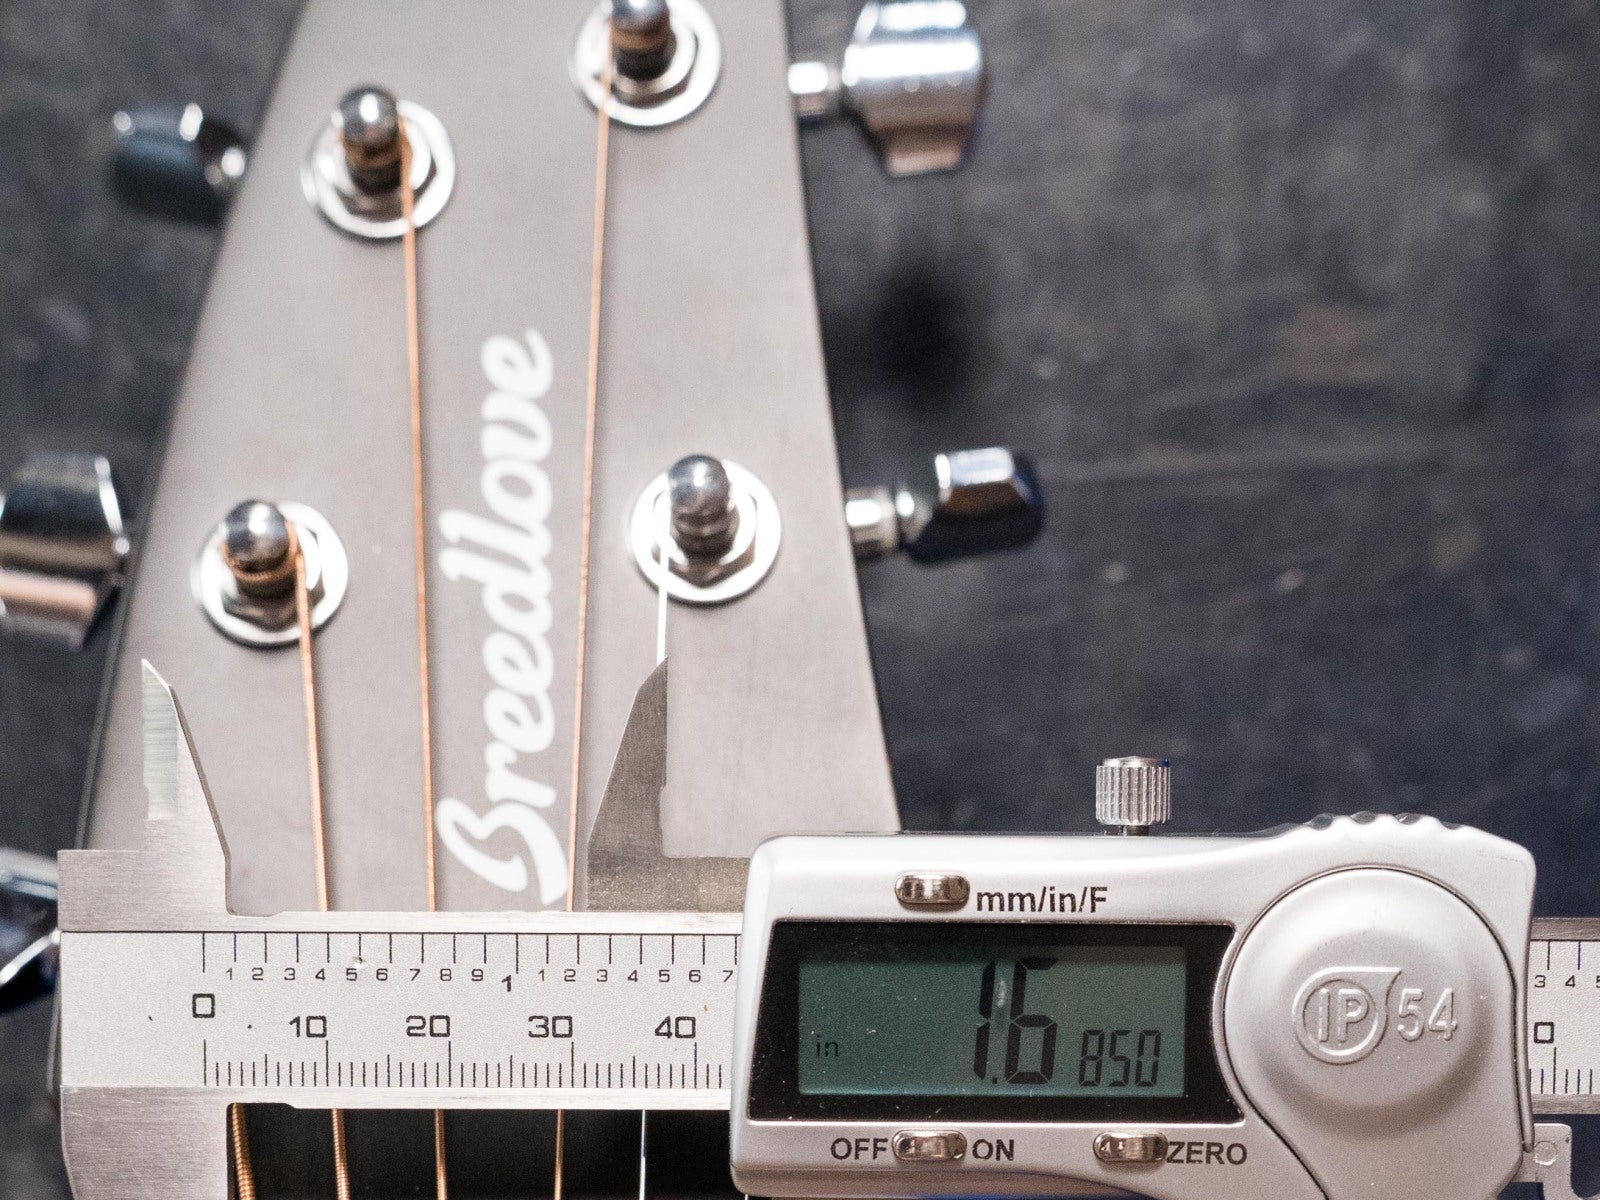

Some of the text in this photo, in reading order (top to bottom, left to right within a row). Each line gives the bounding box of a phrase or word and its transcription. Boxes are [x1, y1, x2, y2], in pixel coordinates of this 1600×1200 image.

[436, 328, 569, 905] Breedlove
[976, 886, 1108, 913] mm/in/F
[225, 967, 734, 993] 1 2 3 4 5 6 7 8 9 1 1 2 3 4 5 6 7
[1534, 974, 1576, 988] 3 4
[191, 993, 697, 1039] 0 10 20 30 40
[1316, 987, 1458, 1044] IP 54
[815, 1034, 840, 1058] in
[830, 1137, 1015, 1162] OFF ON
[1165, 1140, 1249, 1166] ZERO
